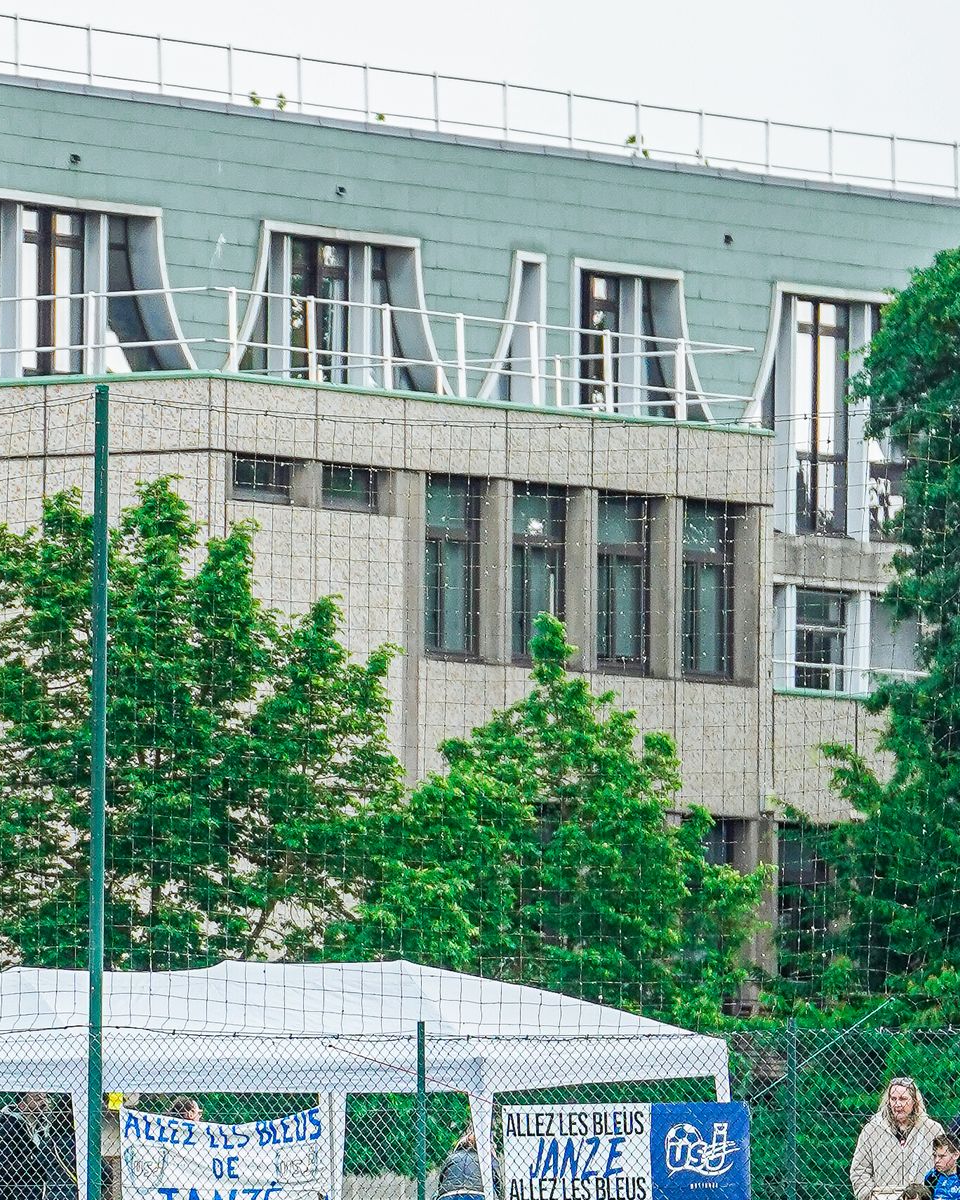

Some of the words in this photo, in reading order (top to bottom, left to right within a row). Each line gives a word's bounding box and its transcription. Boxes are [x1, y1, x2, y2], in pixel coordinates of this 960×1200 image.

[124, 1112, 197, 1146] ALLEZ
[255, 1107, 322, 1147] BLEUS
[506, 1111, 556, 1137] ALLEZ
[559, 1111, 589, 1136] LES
[592, 1110, 645, 1136] BLEUS
[212, 1155, 240, 1179] DE
[529, 1136, 627, 1181] JANZE
[594, 1176, 647, 1200] BLEUS
